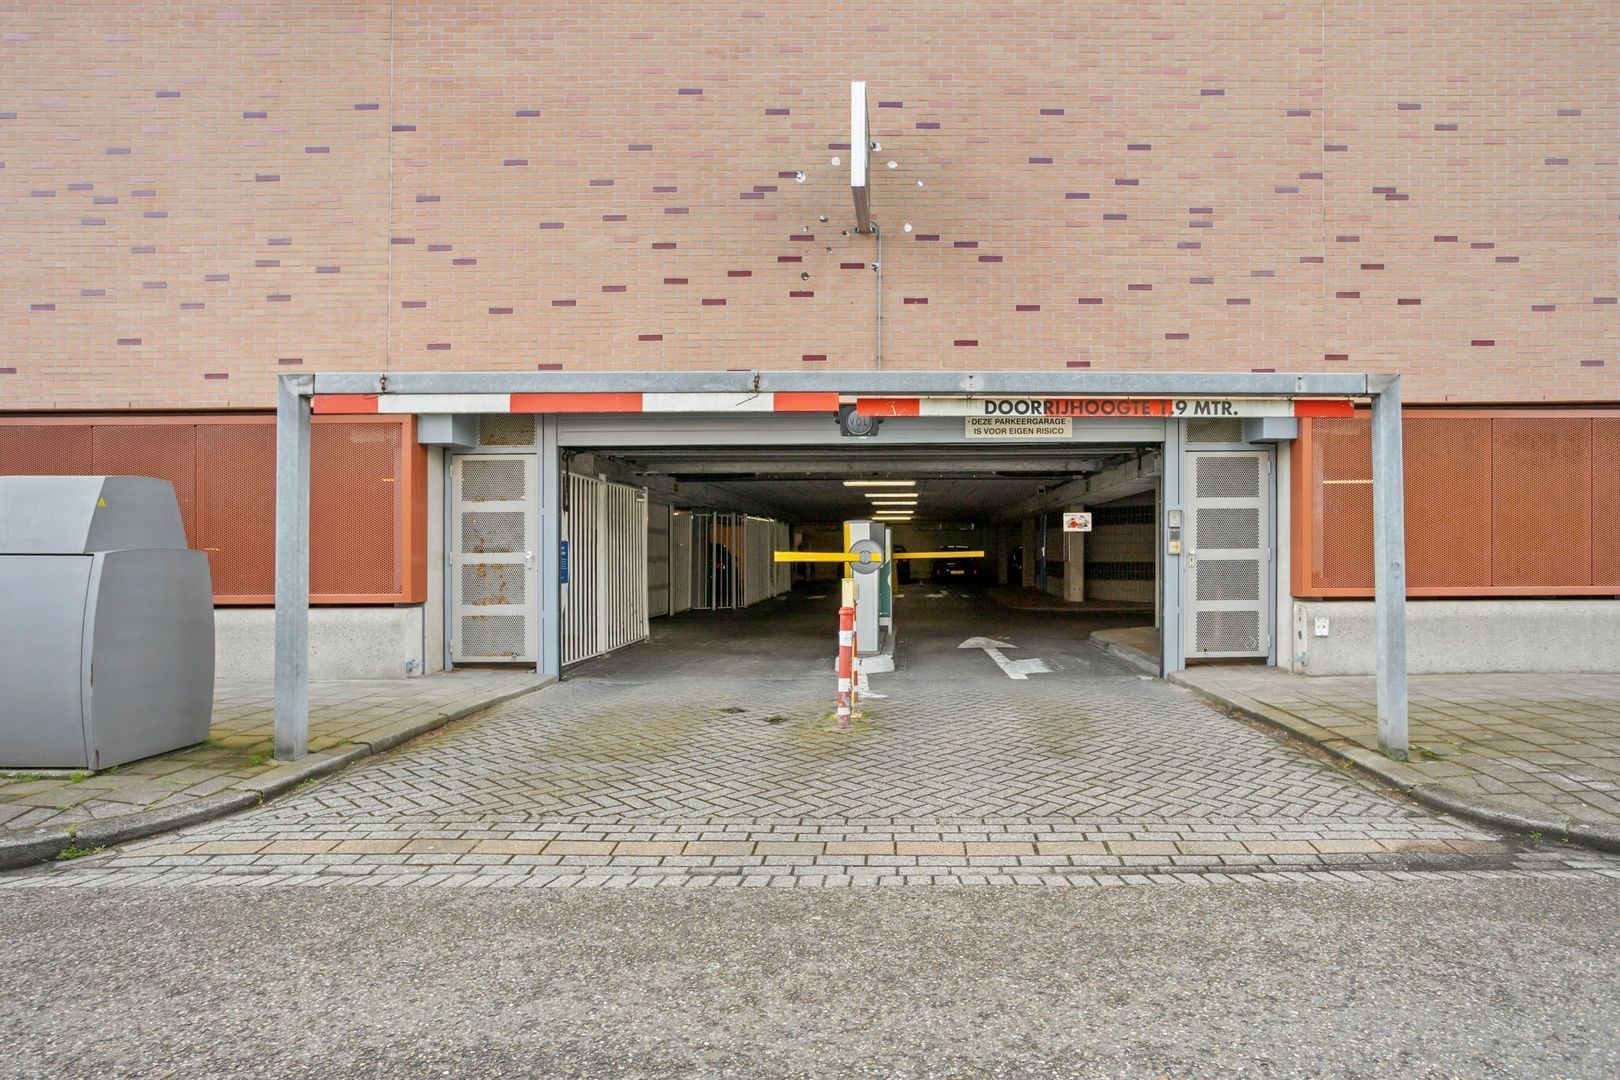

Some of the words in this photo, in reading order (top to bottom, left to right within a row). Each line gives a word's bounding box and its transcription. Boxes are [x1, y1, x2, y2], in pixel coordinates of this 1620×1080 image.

[984, 400, 1150, 415] DOORRIJHOOGTE
[1161, 400, 1187, 415] 1.9
[1193, 400, 1238, 415] MTR.
[994, 417, 1066, 425] PARKEERGARAGE
